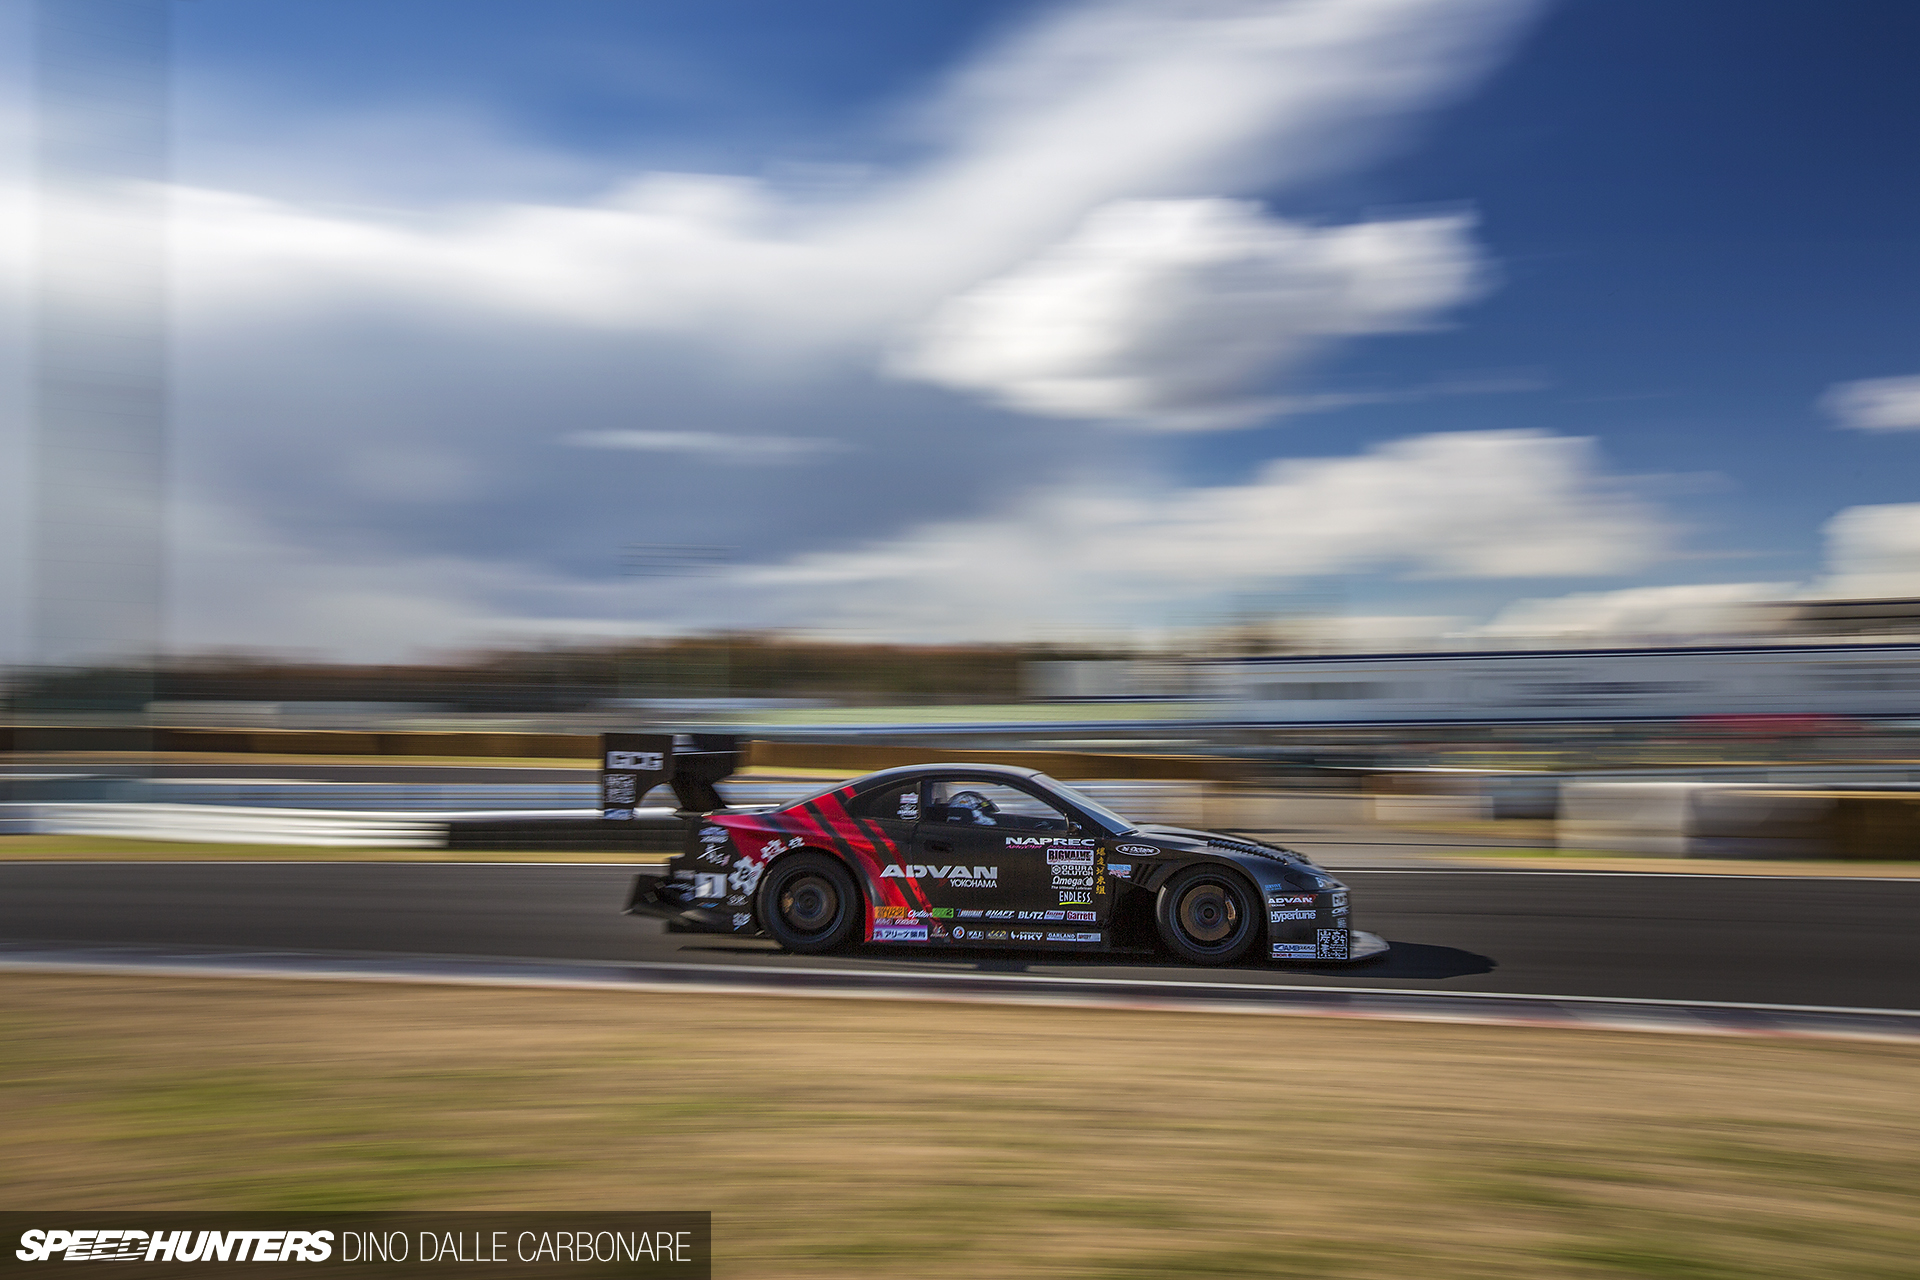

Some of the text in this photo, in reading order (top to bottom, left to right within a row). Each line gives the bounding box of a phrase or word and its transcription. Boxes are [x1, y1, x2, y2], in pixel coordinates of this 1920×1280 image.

[1005, 837, 1095, 846] NAPREC
[880, 864, 998, 879] ADVAN
[950, 879, 998, 888] YOKOHAMA
[1059, 890, 1092, 903] ENDLESS
[907, 909, 933, 918] Option
[1018, 911, 1044, 920] BLITZ
[1067, 911, 1094, 920] Garrett
[1270, 908, 1316, 923] Hypertune
